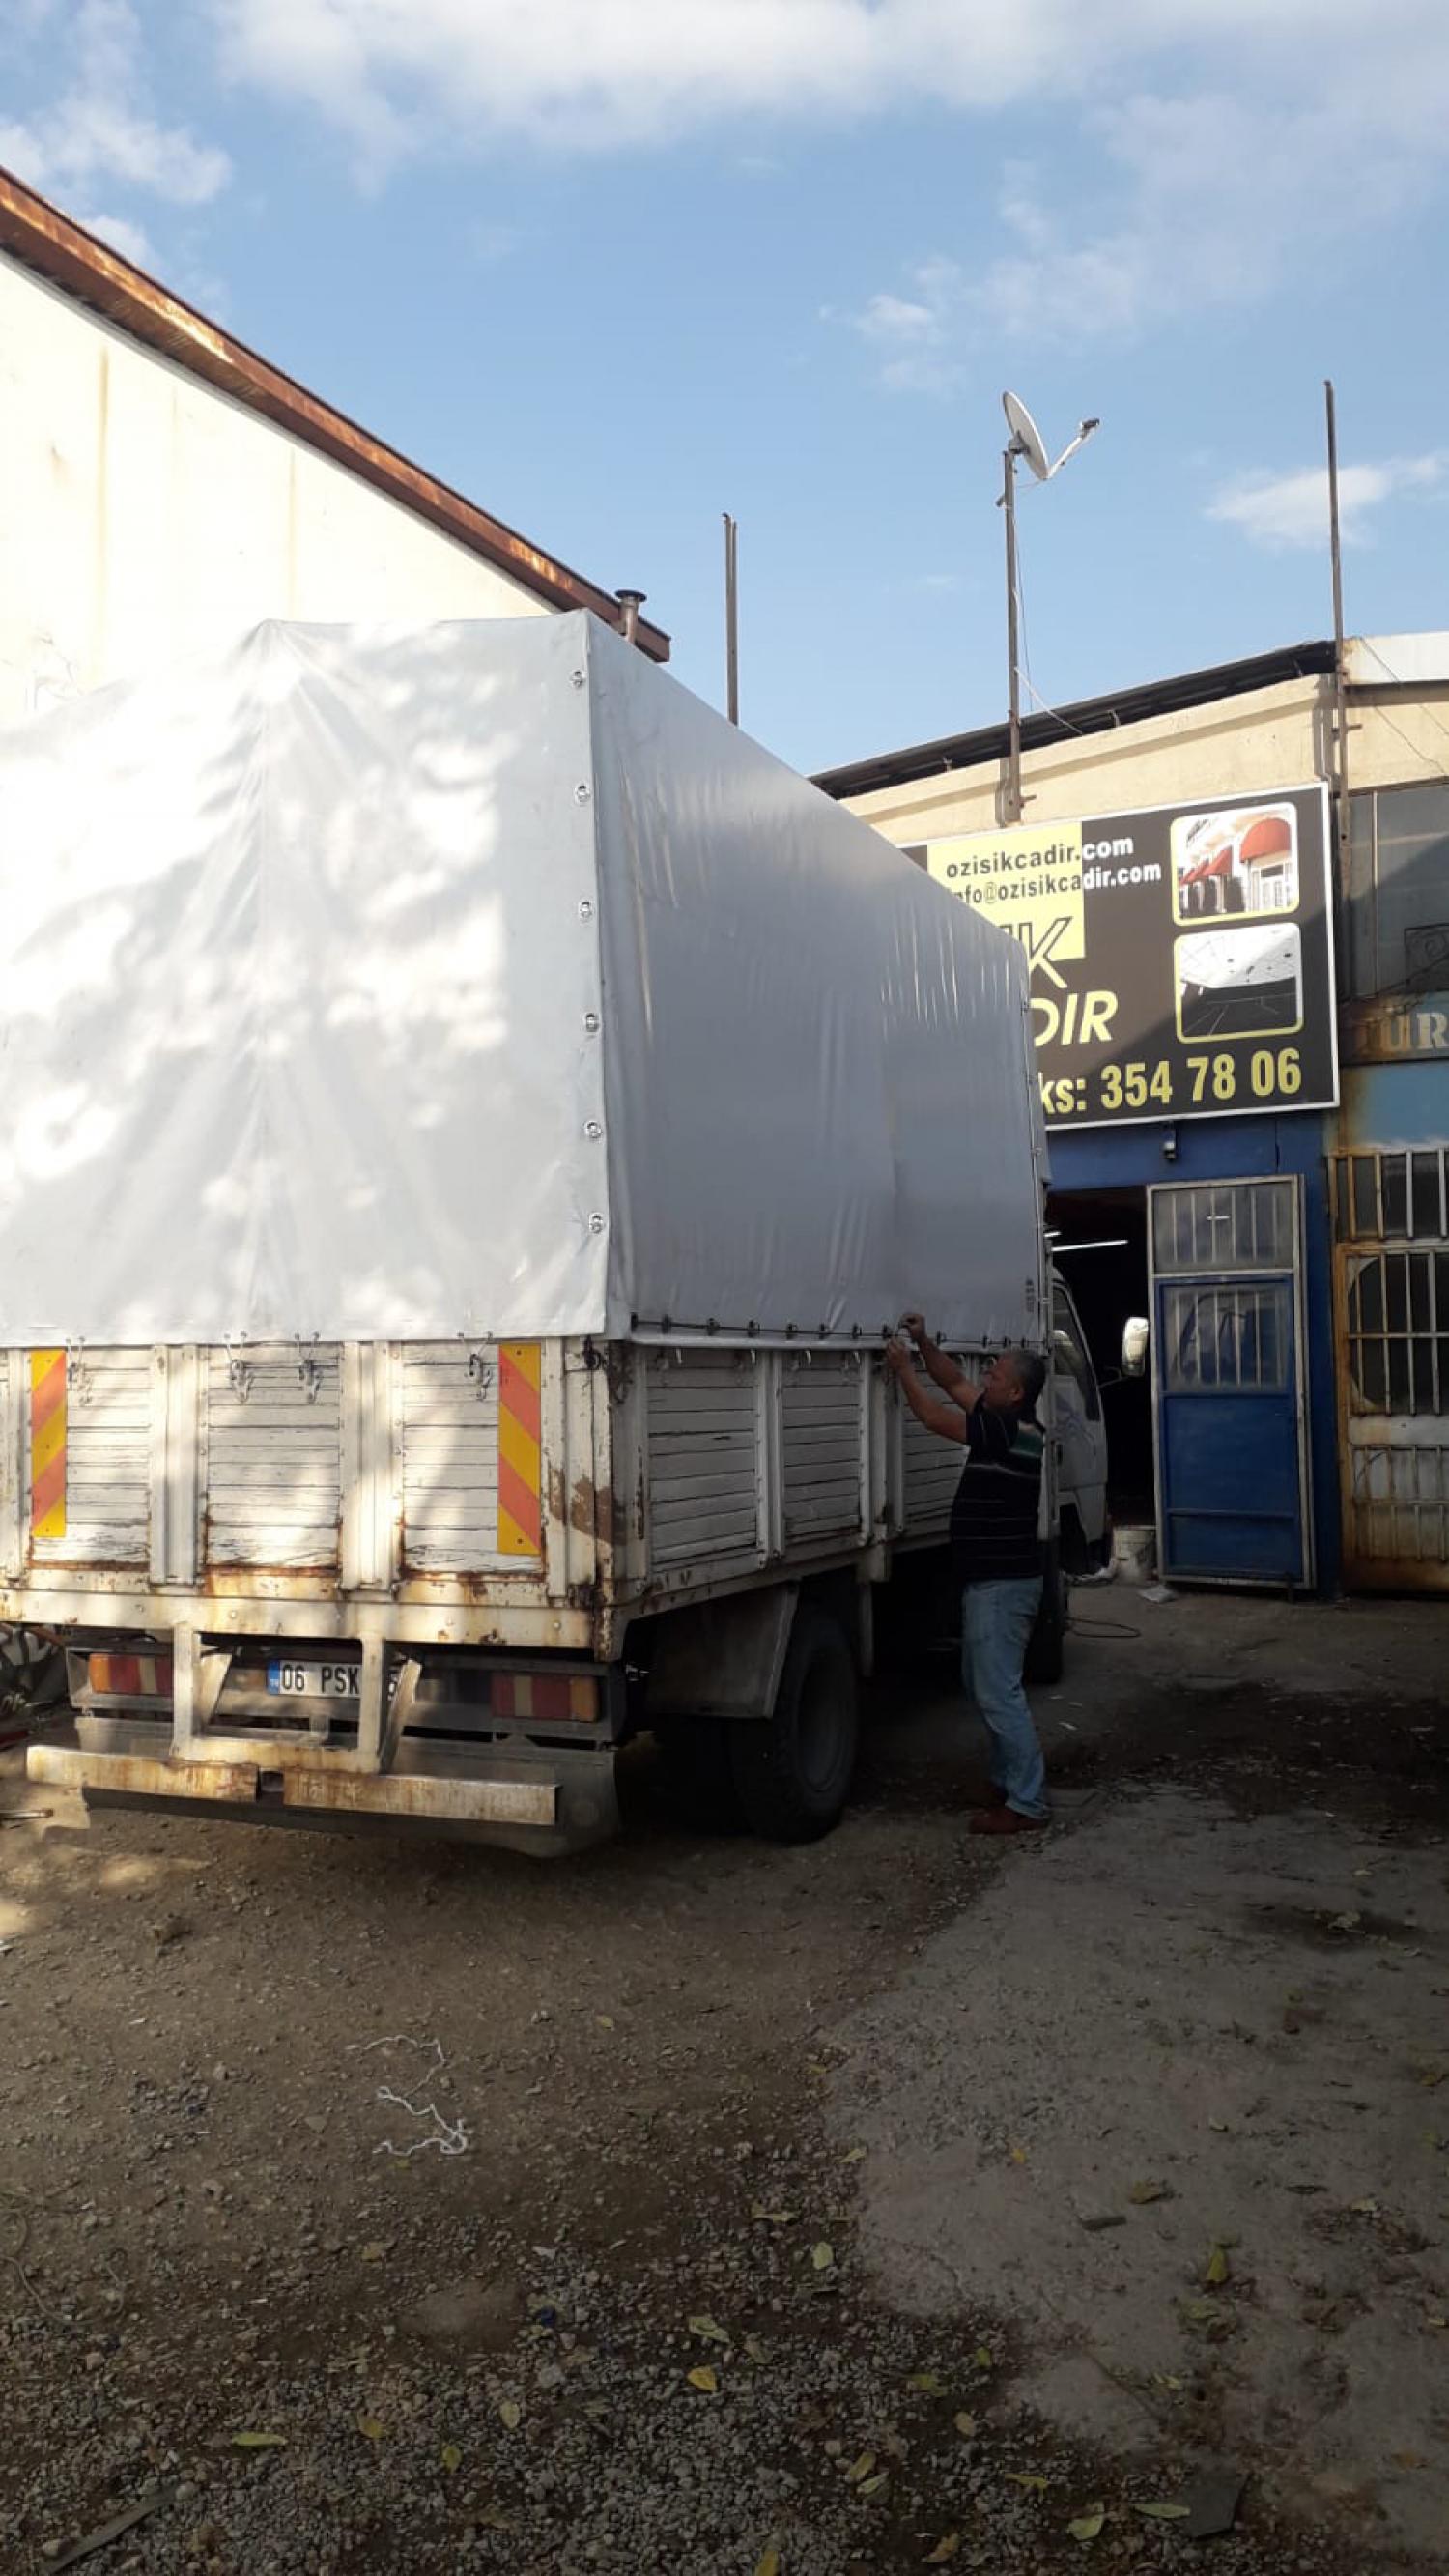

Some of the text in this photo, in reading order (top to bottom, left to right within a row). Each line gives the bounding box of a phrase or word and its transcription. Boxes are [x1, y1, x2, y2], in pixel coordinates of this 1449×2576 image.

[947, 836, 1134, 879] ozisikcadir.com
[1100, 1060, 1173, 1110] 354
[1186, 1053, 1236, 1102] 78
[1251, 1047, 1302, 1098] 06
[282, 1664, 305, 1691] 06
[321, 1666, 360, 1694] PSK
